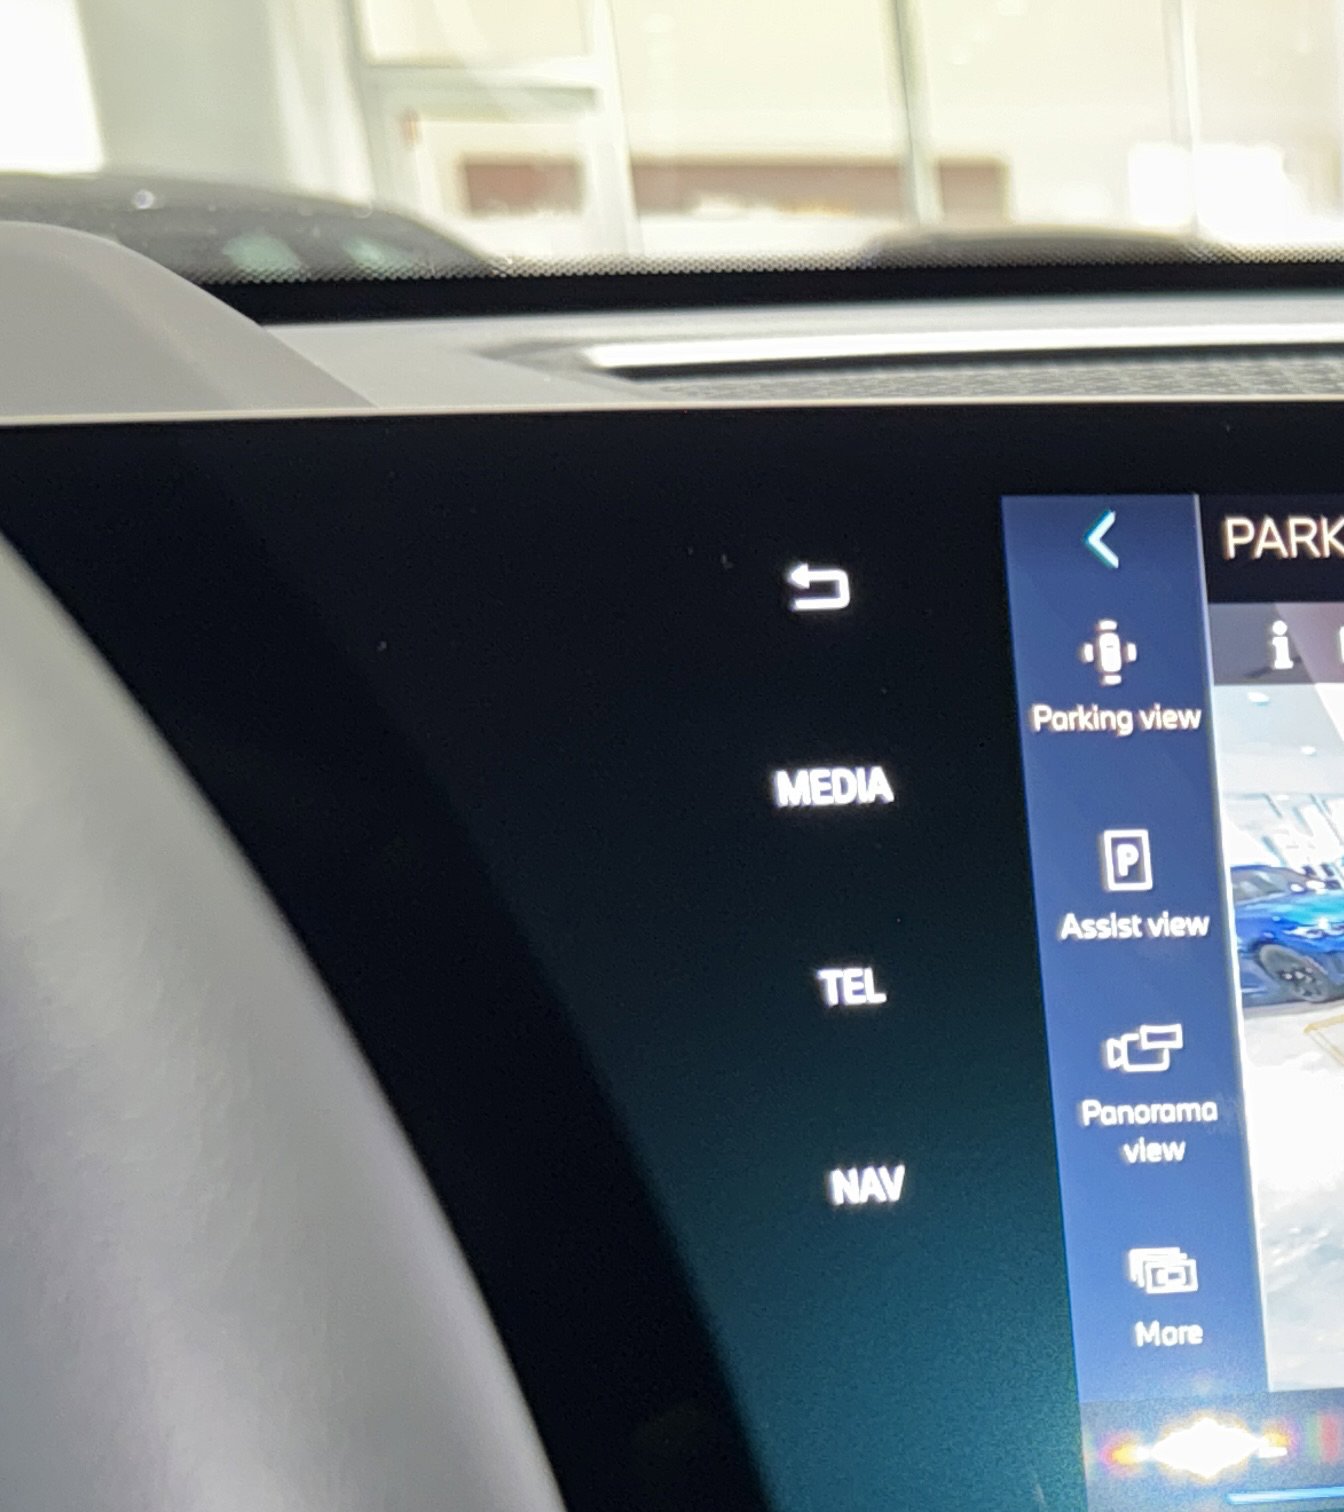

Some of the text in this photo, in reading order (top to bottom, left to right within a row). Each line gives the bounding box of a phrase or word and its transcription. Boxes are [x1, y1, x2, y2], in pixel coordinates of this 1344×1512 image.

[1031, 704, 1202, 736] Parking view
[774, 766, 895, 808] MEDIA
[1059, 911, 1210, 941] Assist view
[817, 967, 888, 1007] TEL
[1080, 1099, 1219, 1128] Panorama
[1123, 1137, 1187, 1164] view
[830, 1165, 906, 1206] NAV
[1135, 1320, 1204, 1348] More
